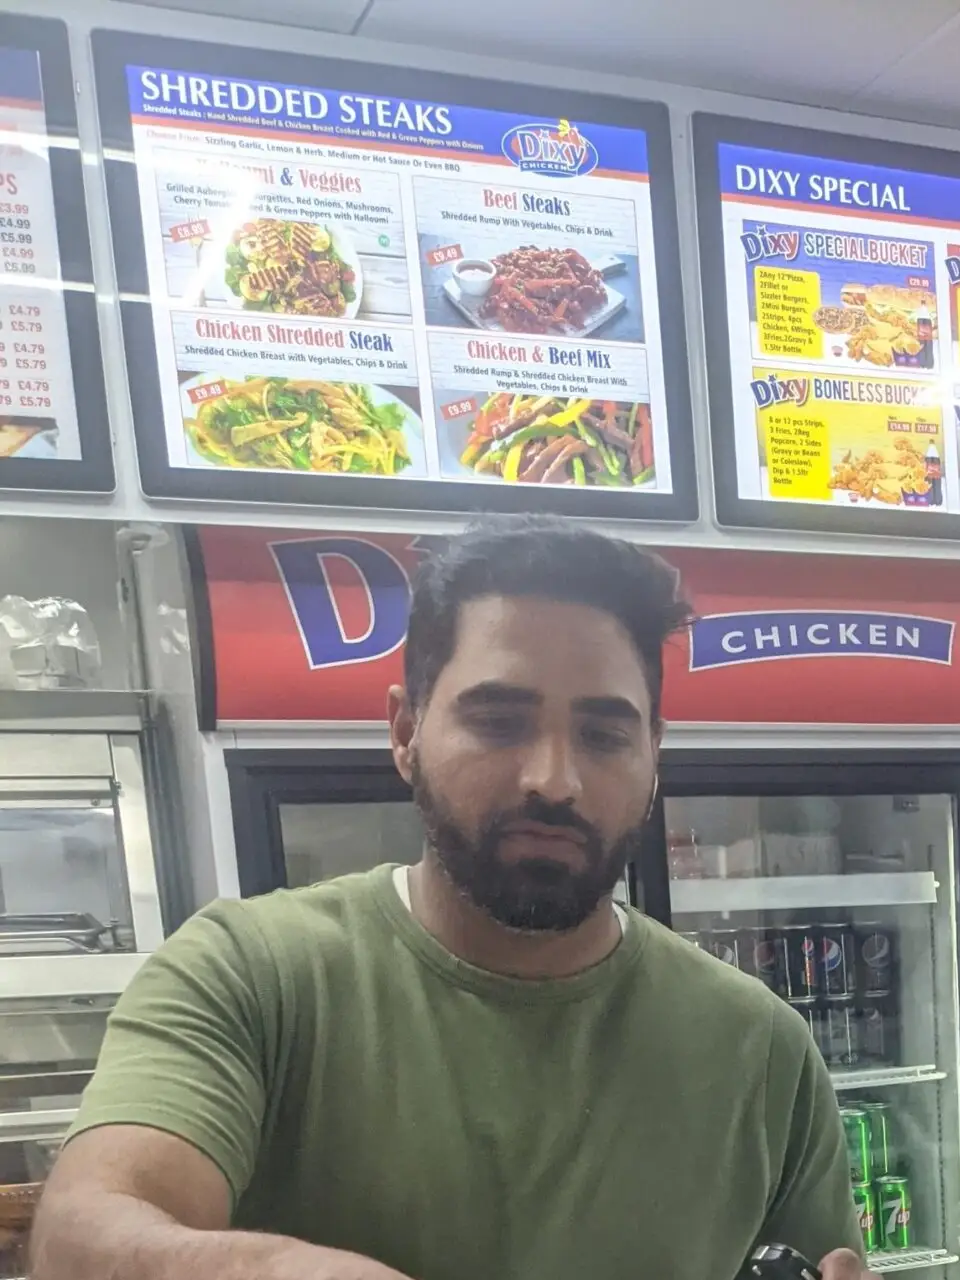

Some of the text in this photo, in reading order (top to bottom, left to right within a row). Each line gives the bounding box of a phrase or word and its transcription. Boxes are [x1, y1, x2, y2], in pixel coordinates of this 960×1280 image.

[140, 69, 329, 121] SHREDDED
[340, 94, 453, 136] STEAKS
[516, 126, 586, 172] Dixy
[521, 160, 569, 174] CHICKEN
[278, 166, 294, 187] &
[298, 168, 362, 196] Veggies
[735, 163, 911, 212] DIXY SPECIAL
[482, 188, 571, 217] Beef Steaks
[441, 210, 613, 237] Shredded Rump With Vegetables, Chips & Drink
[739, 221, 801, 268] Dixy
[9, 304, 41, 317] £4.79
[10, 320, 43, 333] £5.79
[194, 317, 394, 352] Chicken Shredded Steak
[13, 342, 45, 354] £4.79
[184, 344, 408, 370] Shredded Chicken Breast with Vegetables, Chips & Drink
[466, 339, 611, 369] Chicken & Beef Mix
[15, 358, 47, 370] £5.79
[453, 364, 627, 386] Shredded Rump & Shredded Chicken Breast With
[18, 380, 50, 392] £4.79
[495, 379, 588, 394] Vegetables, Chips & Drink
[749, 371, 811, 413] Dixy
[19, 395, 51, 408] £5.79
[720, 621, 922, 655] CHICKEN
